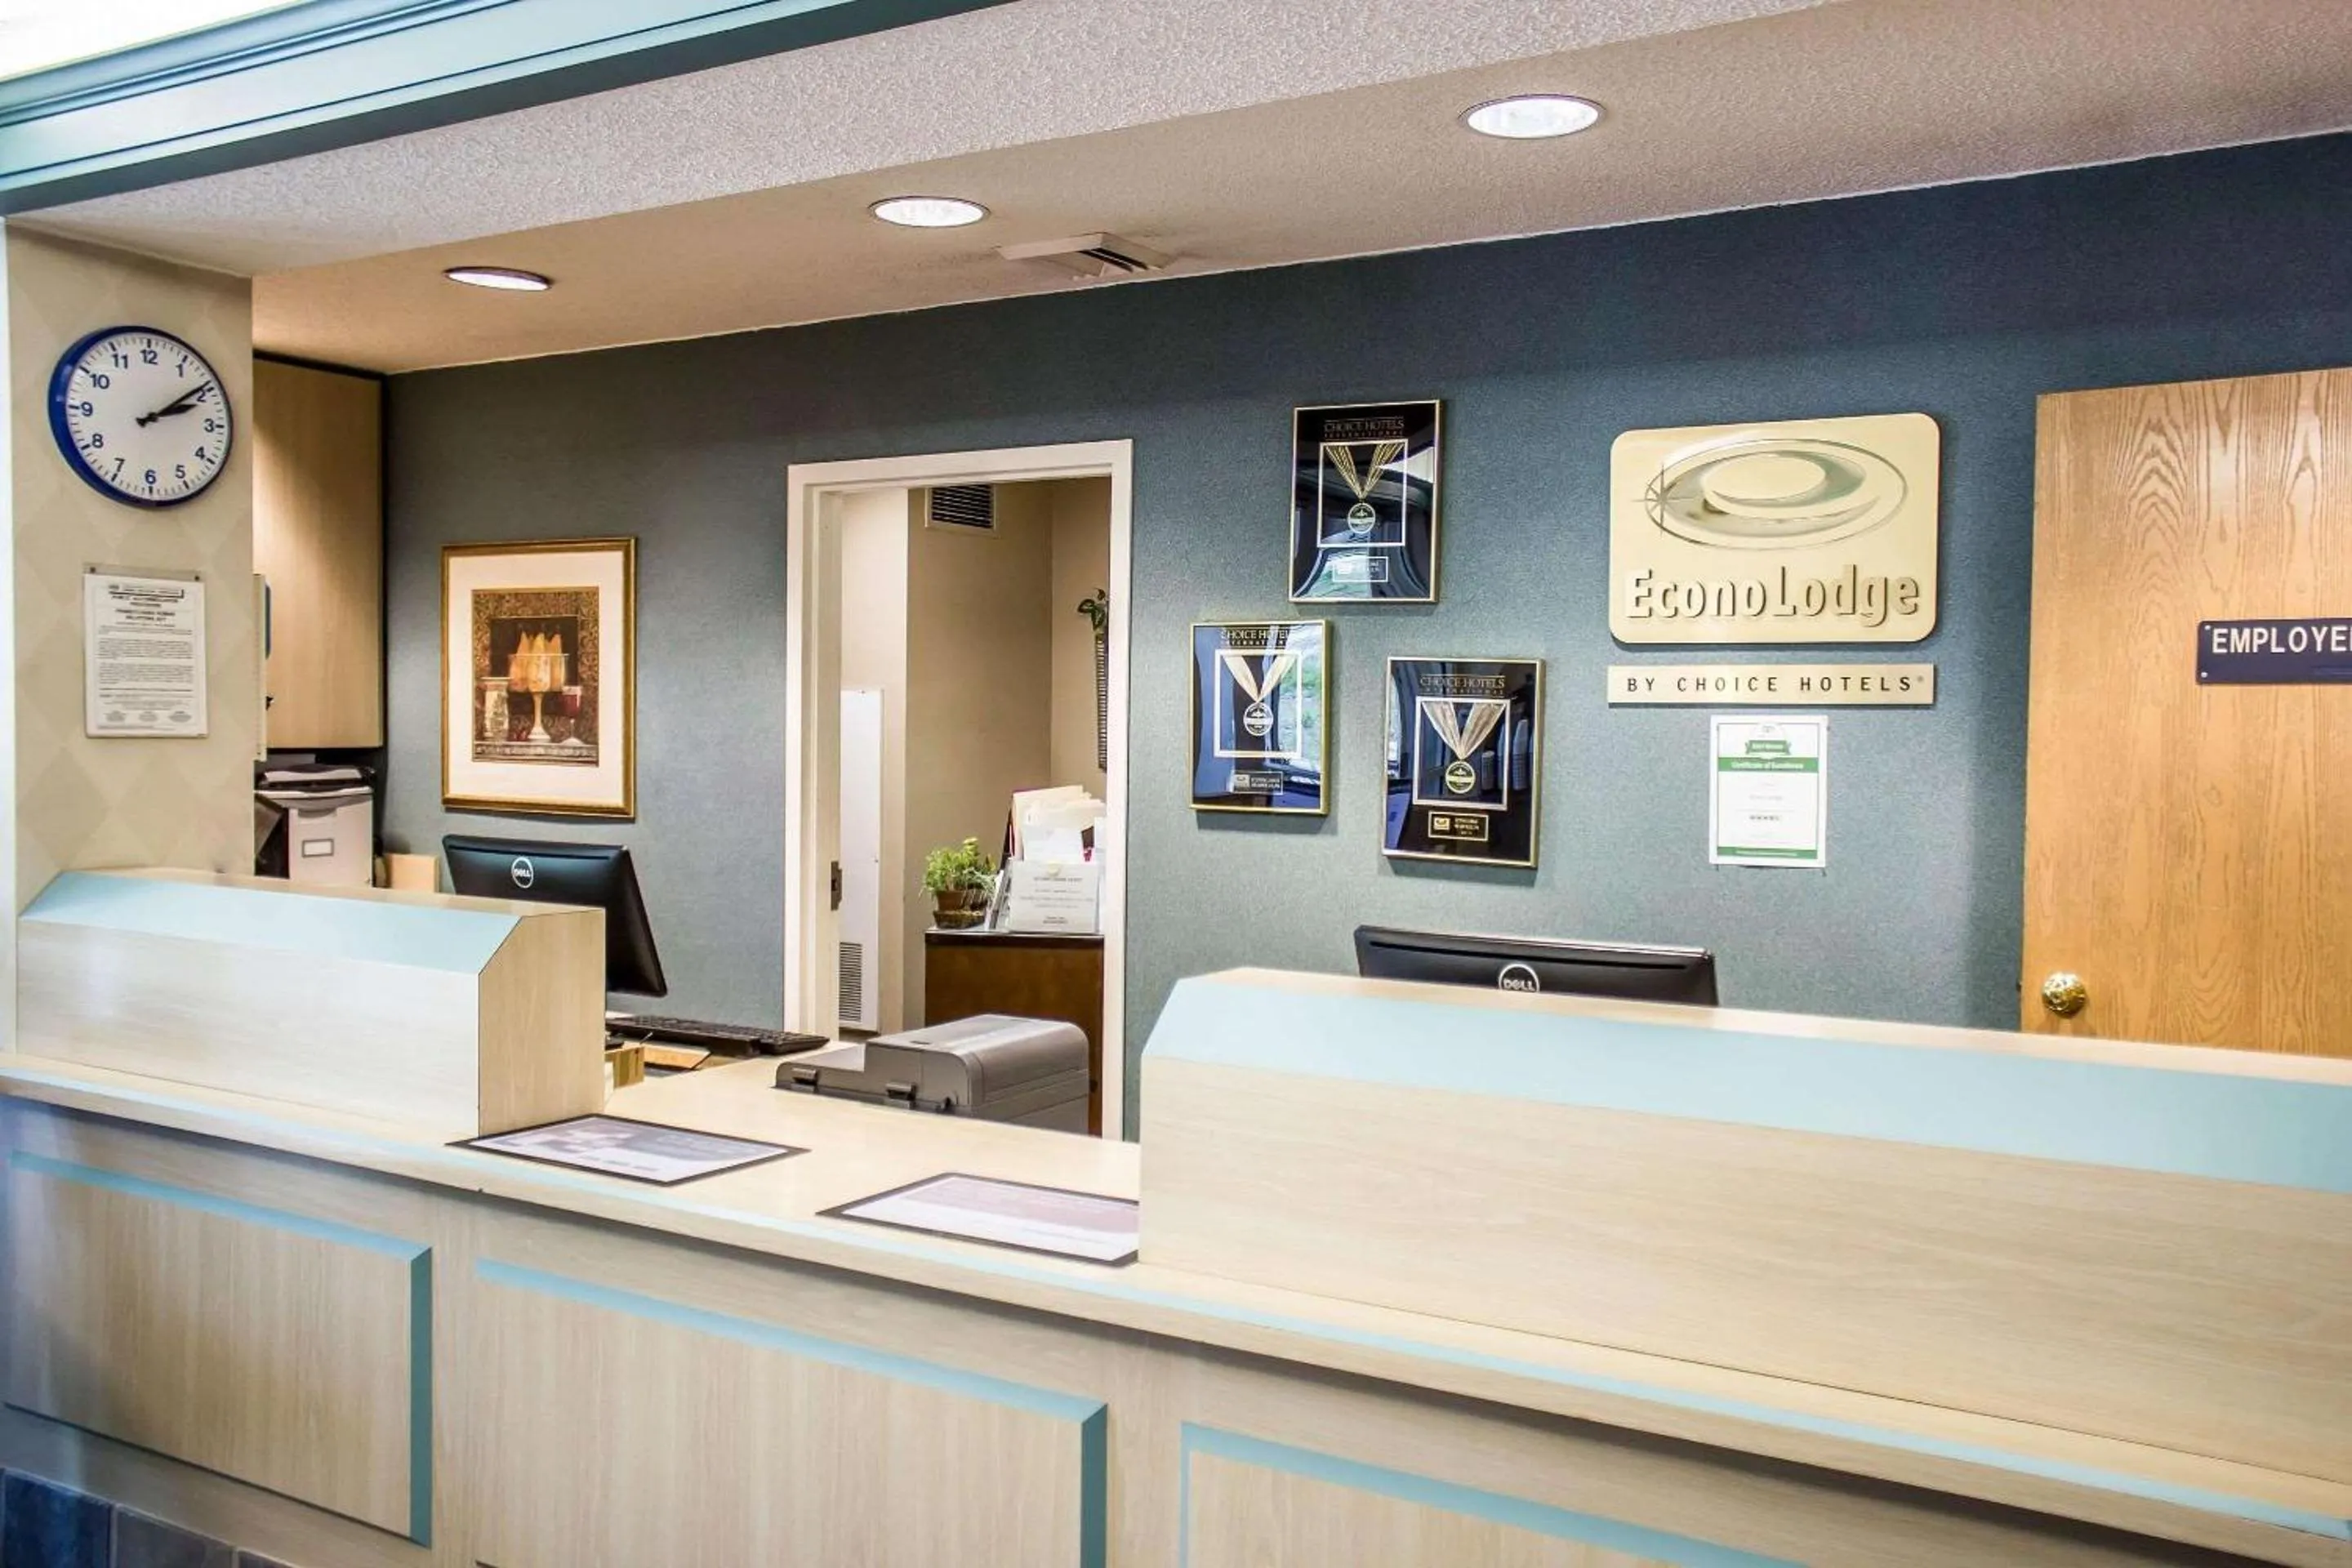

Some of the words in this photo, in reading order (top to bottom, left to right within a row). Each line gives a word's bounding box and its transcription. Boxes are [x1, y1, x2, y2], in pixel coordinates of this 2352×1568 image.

[112, 354, 129, 369] 11
[140, 350, 158, 365] 12
[176, 363, 185, 378] 1
[90, 374, 110, 390] 10
[196, 388, 207, 403] 2
[80, 402, 93, 416] 9
[203, 418, 216, 433] 3
[91, 434, 104, 448] 8
[194, 447, 206, 460] 4
[114, 457, 126, 472] 7
[175, 465, 186, 479] 5
[145, 470, 157, 484] 6
[2212, 626, 2352, 653] EMPLOYE
[1420, 676, 1463, 687] CHOICE
[1464, 678, 1505, 689] HOTELS
[1627, 677, 1655, 693] BY
[1677, 676, 1778, 693] CHOICE
[1799, 676, 1912, 692] HOTELS
[514, 868, 531, 877] DELL
[1503, 978, 1536, 992] DELL
